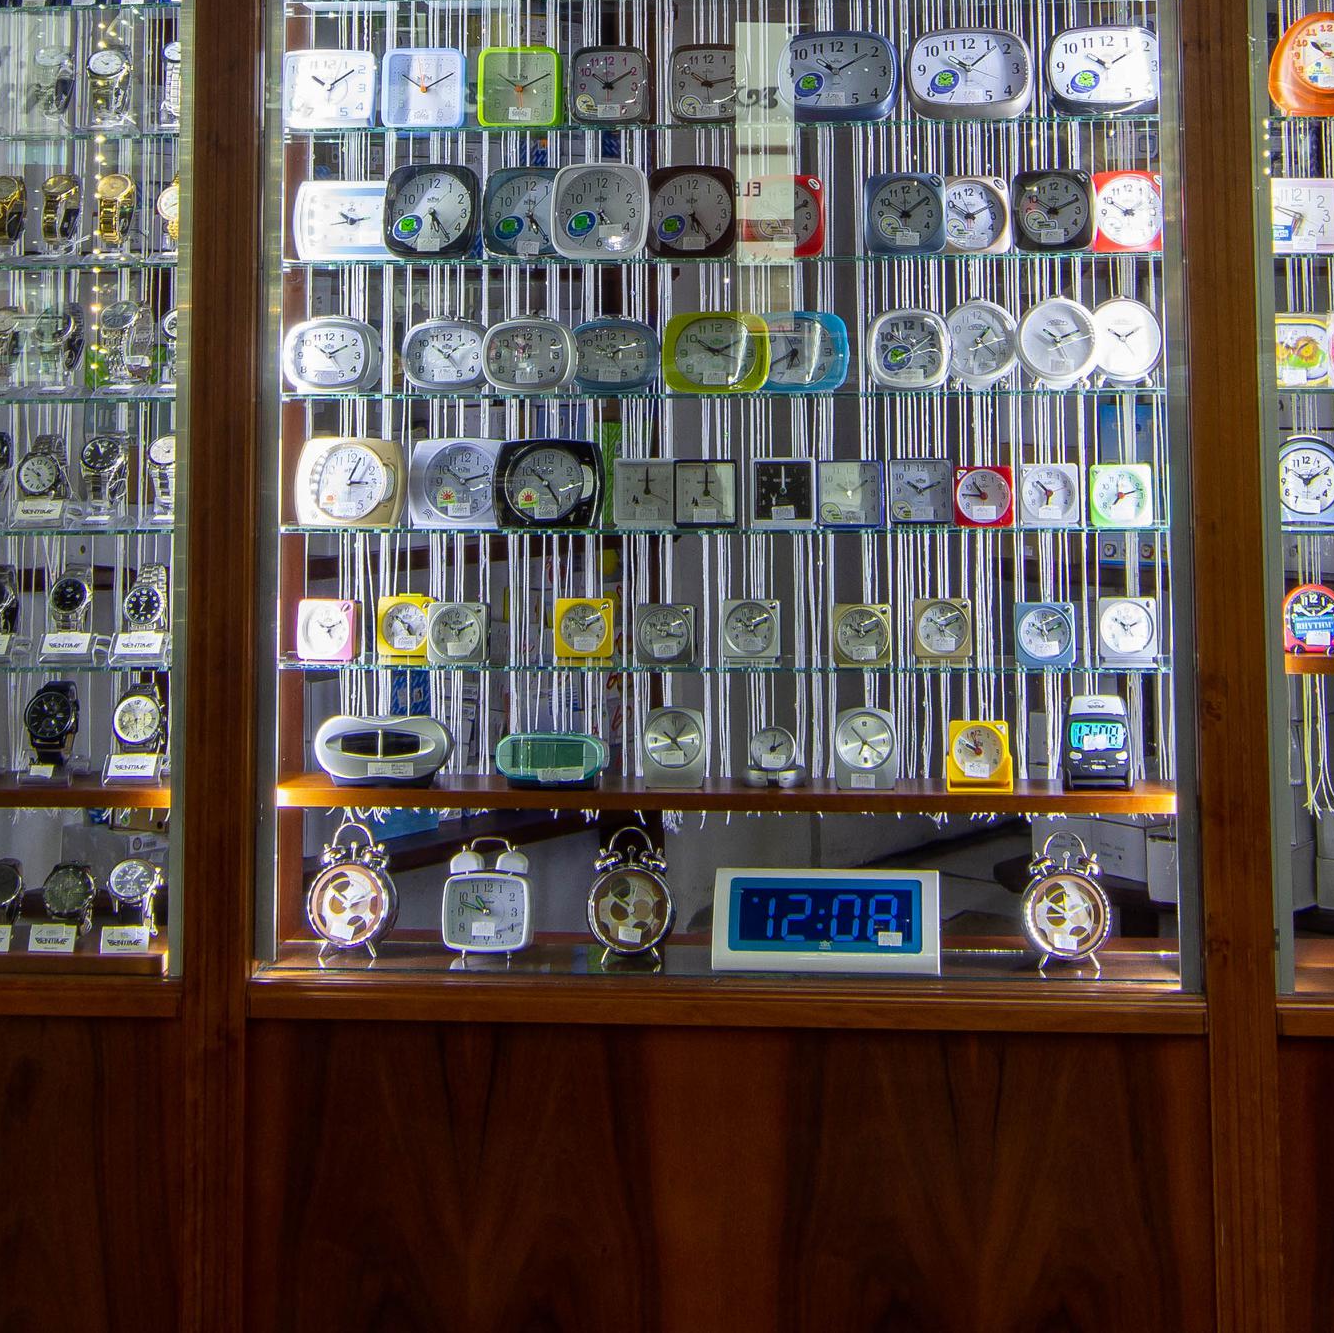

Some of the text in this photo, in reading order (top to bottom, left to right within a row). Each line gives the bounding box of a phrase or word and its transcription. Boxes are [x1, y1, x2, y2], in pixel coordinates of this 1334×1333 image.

[829, 40, 844, 53] 12
[961, 37, 976, 50] 12
[924, 45, 940, 58] 10
[1296, 621, 1332, 630] RHYTHM
[49, 642, 83, 650] BENTIME
[107, 938, 143, 947] BENTIME
